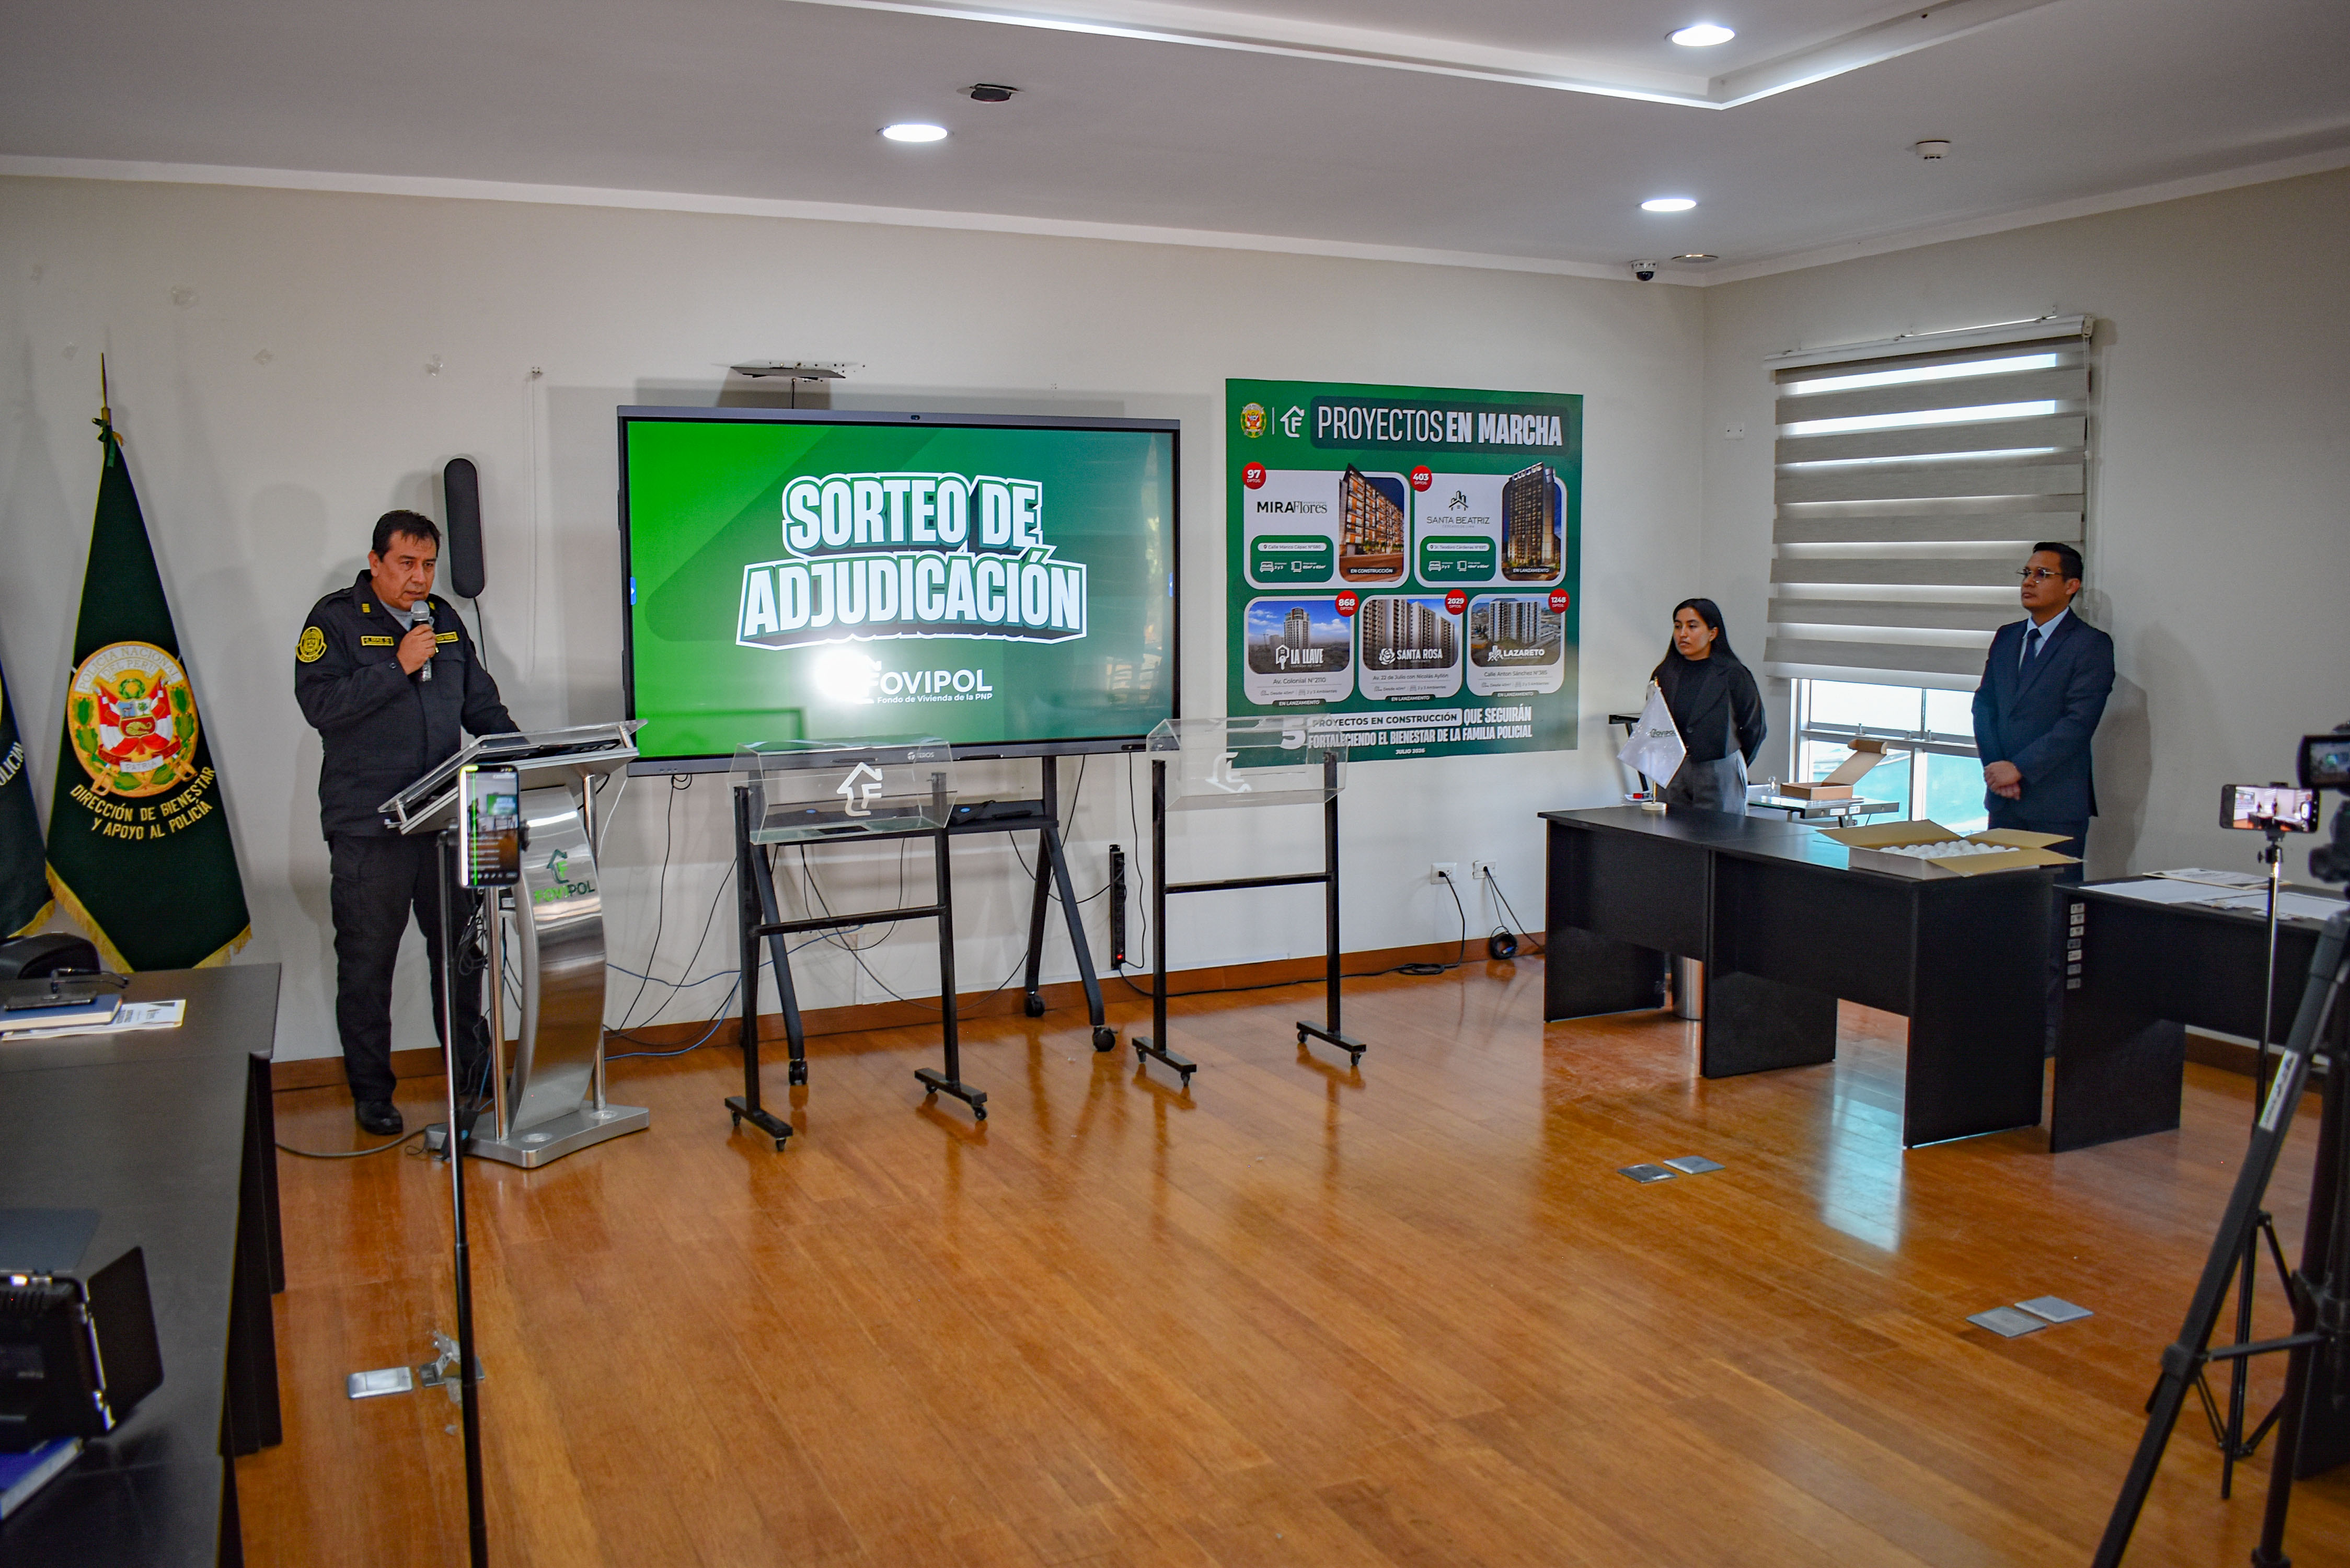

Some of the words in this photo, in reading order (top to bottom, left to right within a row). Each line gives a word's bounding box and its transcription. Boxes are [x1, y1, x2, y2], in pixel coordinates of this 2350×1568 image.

[1318, 406, 1443, 442] PROYECTOS
[1446, 411, 1472, 443] EN
[1478, 412, 1562, 446] MARCHA
[1247, 469, 1261, 479] 97
[788, 479, 968, 551] SORTEO
[978, 481, 1039, 548] DE
[743, 550, 1081, 636] ADJUDICACIÓN
[1291, 649, 1300, 664] LA
[1303, 648, 1324, 664] LLAVE
[1397, 649, 1421, 660] SANTA
[1423, 648, 1443, 659] ROSA
[1503, 649, 1545, 657] LAZARETO
[79, 651, 118, 690] POLICIA
[102, 662, 123, 678] DEL
[126, 660, 157, 672] PERU
[877, 694, 903, 704] Fondo
[905, 694, 915, 703] de
[916, 694, 952, 702] Vivienda
[954, 693, 965, 701] de
[1312, 717, 1368, 727] PROYECTOS
[1371, 717, 1383, 725] EN
[1386, 712, 1457, 724] CONSTRUCCIÓN
[1464, 708, 1483, 726] QUE
[1484, 704, 1533, 724] SEGUIRÁN
[1280, 717, 1306, 750] 5
[1308, 731, 1377, 748] FORTALECIENDO
[1378, 731, 1389, 745] EL
[1390, 729, 1436, 745] BIENESTAR
[1437, 728, 1448, 742] DE
[1450, 728, 1461, 742] LA
[1462, 726, 1495, 741] FAMILIA
[1497, 724, 1533, 739] POLICIAL
[70, 785, 134, 822] DIRECCIÓN
[140, 806, 157, 822] DE
[159, 766, 215, 817] BIENESTAR
[91, 817, 103, 831] Y
[103, 822, 144, 840] APOYO
[150, 824, 166, 839] AL
[168, 798, 213, 833] POLICÍA
[534, 880, 595, 904] FOVIPOL
